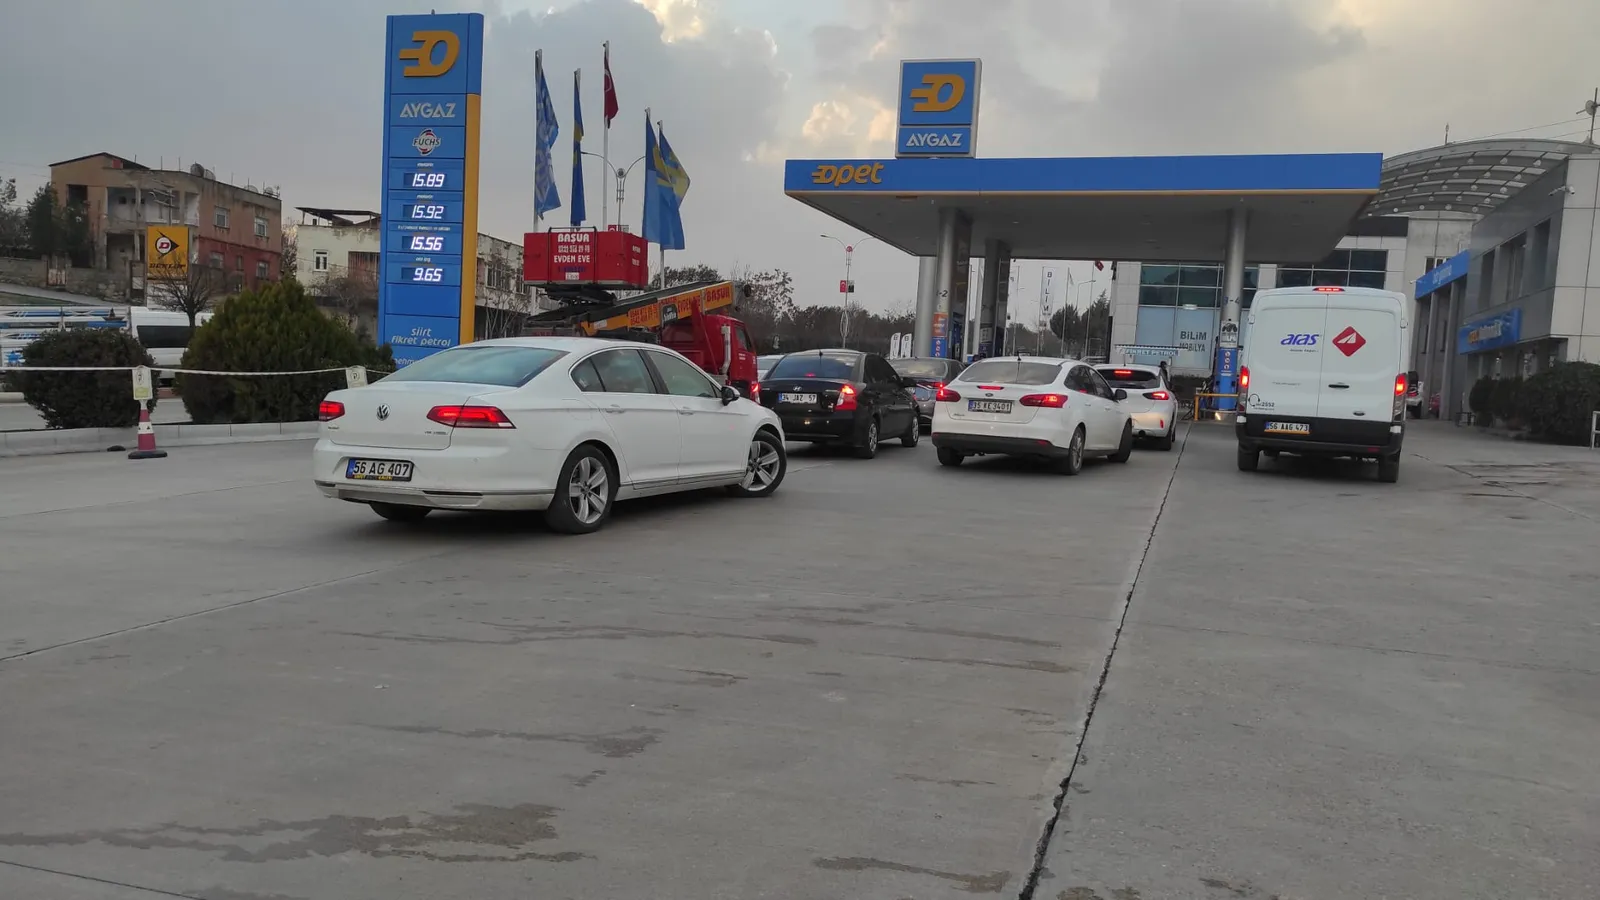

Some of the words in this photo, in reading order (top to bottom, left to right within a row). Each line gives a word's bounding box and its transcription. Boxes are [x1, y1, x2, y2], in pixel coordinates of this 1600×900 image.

[400, 103, 456, 118] AYGAZ
[413, 138, 440, 146] FUCHS
[906, 133, 962, 147] AYGAZ
[412, 173, 445, 187] 15.89
[411, 204, 444, 219] 15.92
[410, 236, 444, 251] 15.56
[554, 255, 576, 263] EVDEN
[578, 255, 590, 263] EVE
[413, 267, 443, 282] 9.65
[411, 327, 432, 337] siirt
[420, 338, 451, 347] petrol
[1280, 333, 1320, 346] aras
[353, 461, 366, 474] 56
[369, 462, 385, 475] AG
[388, 463, 409, 476] 407
